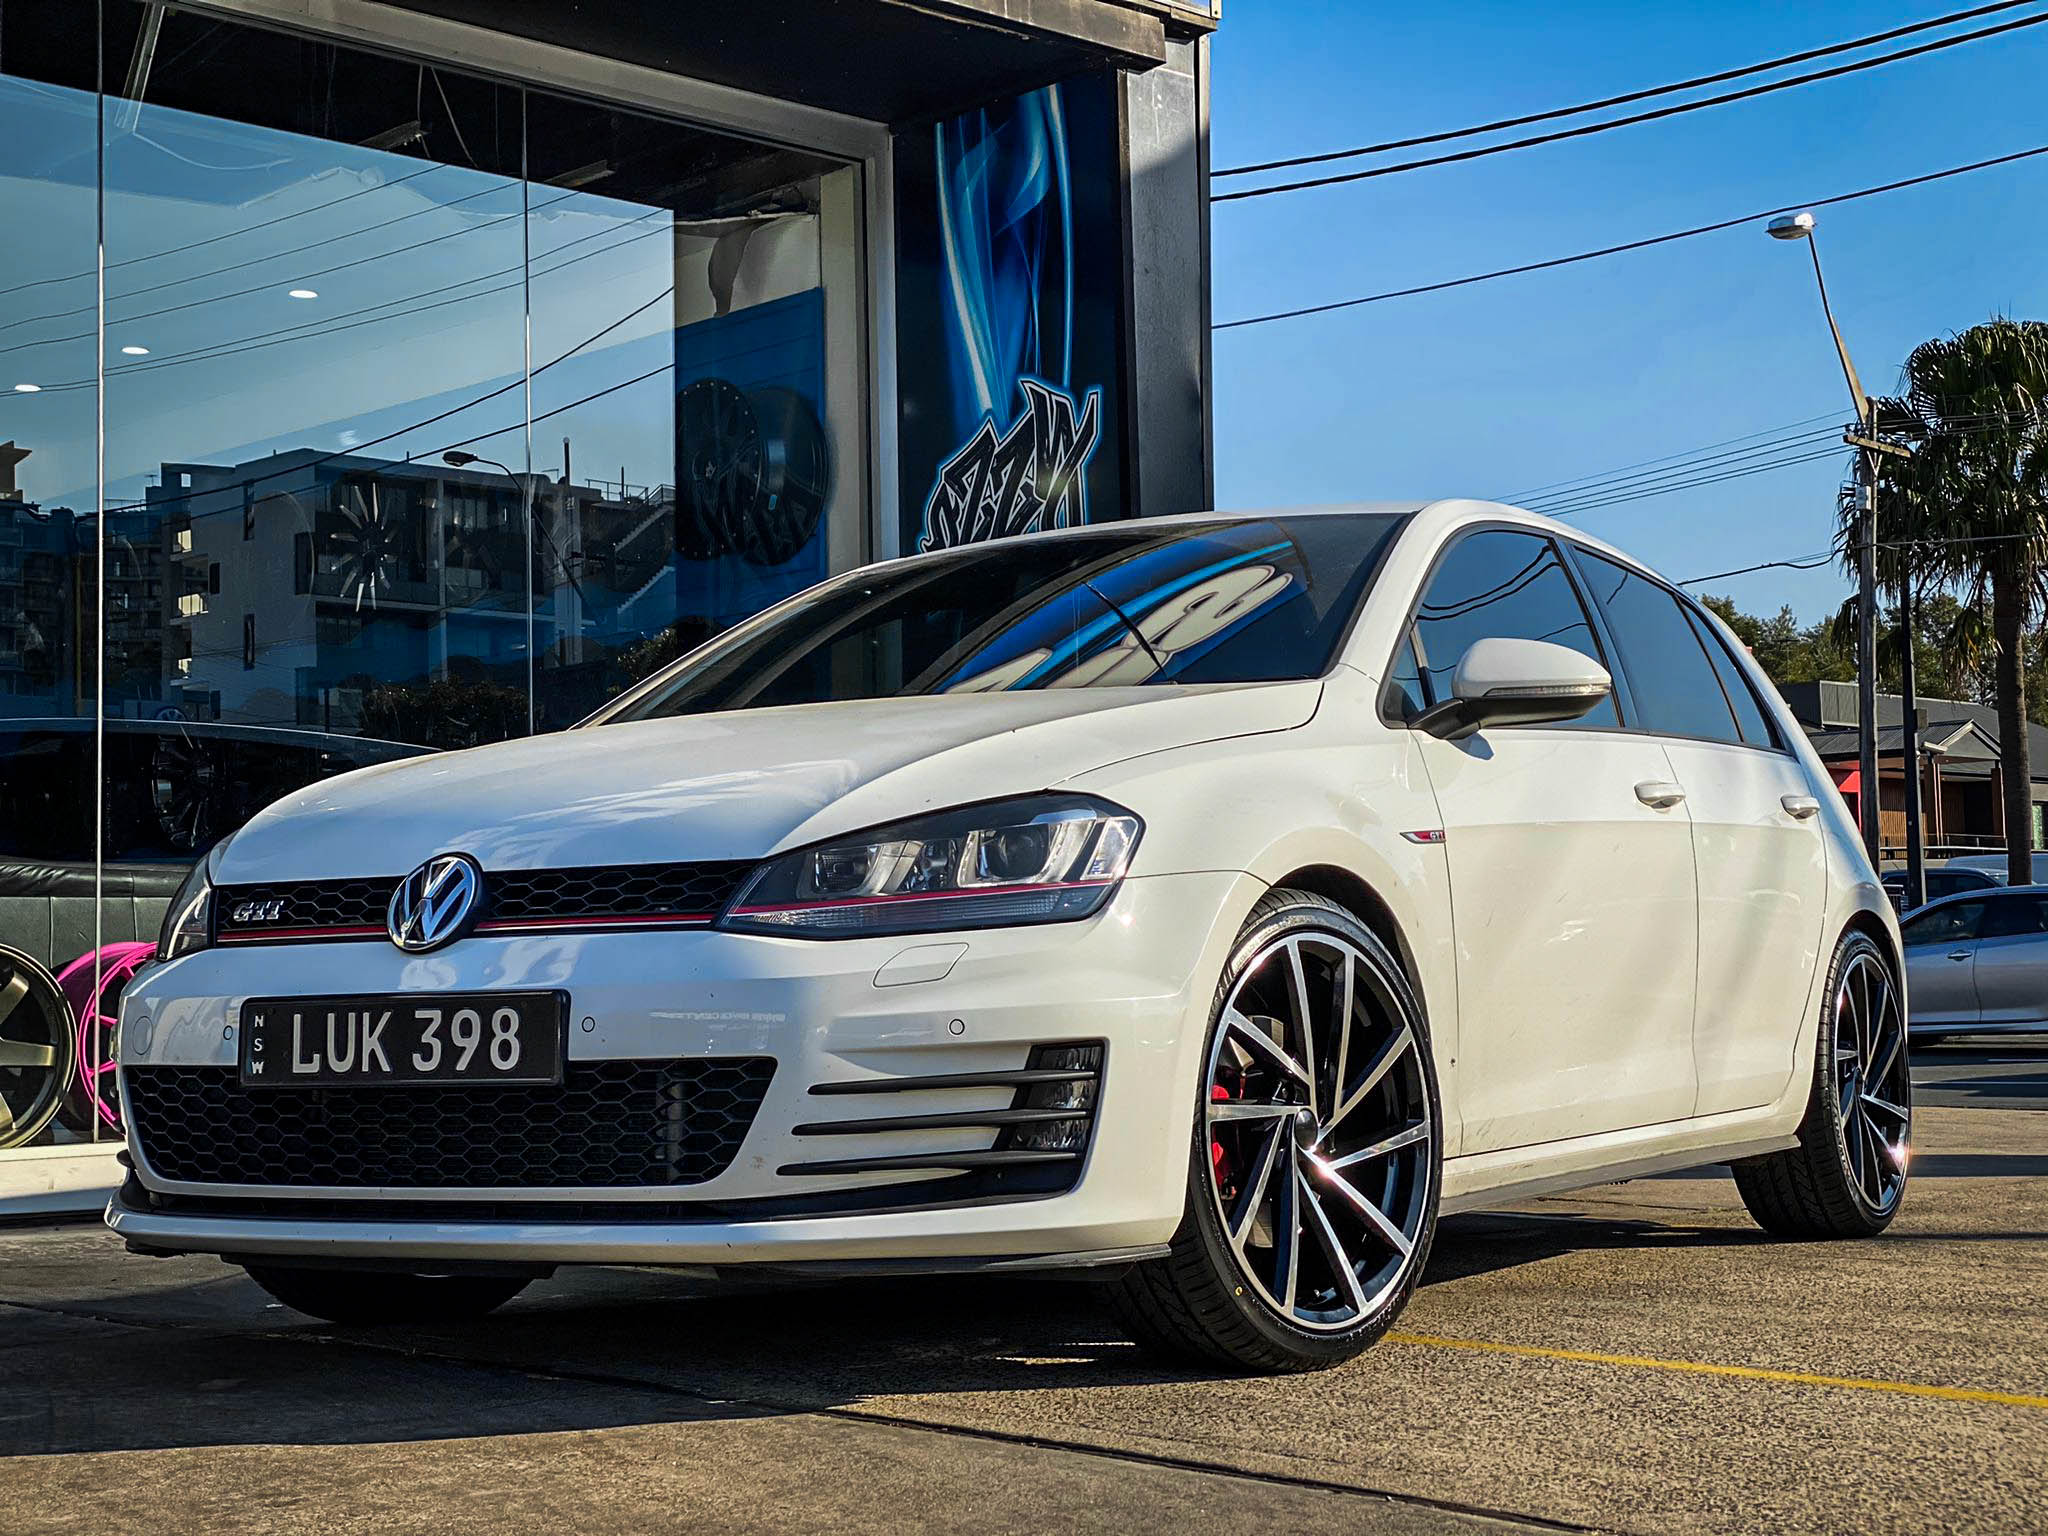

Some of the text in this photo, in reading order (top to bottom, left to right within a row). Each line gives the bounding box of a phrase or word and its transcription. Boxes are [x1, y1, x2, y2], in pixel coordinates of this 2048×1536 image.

[233, 900, 284, 922] GTI
[292, 1007, 521, 1074] LUK 398
